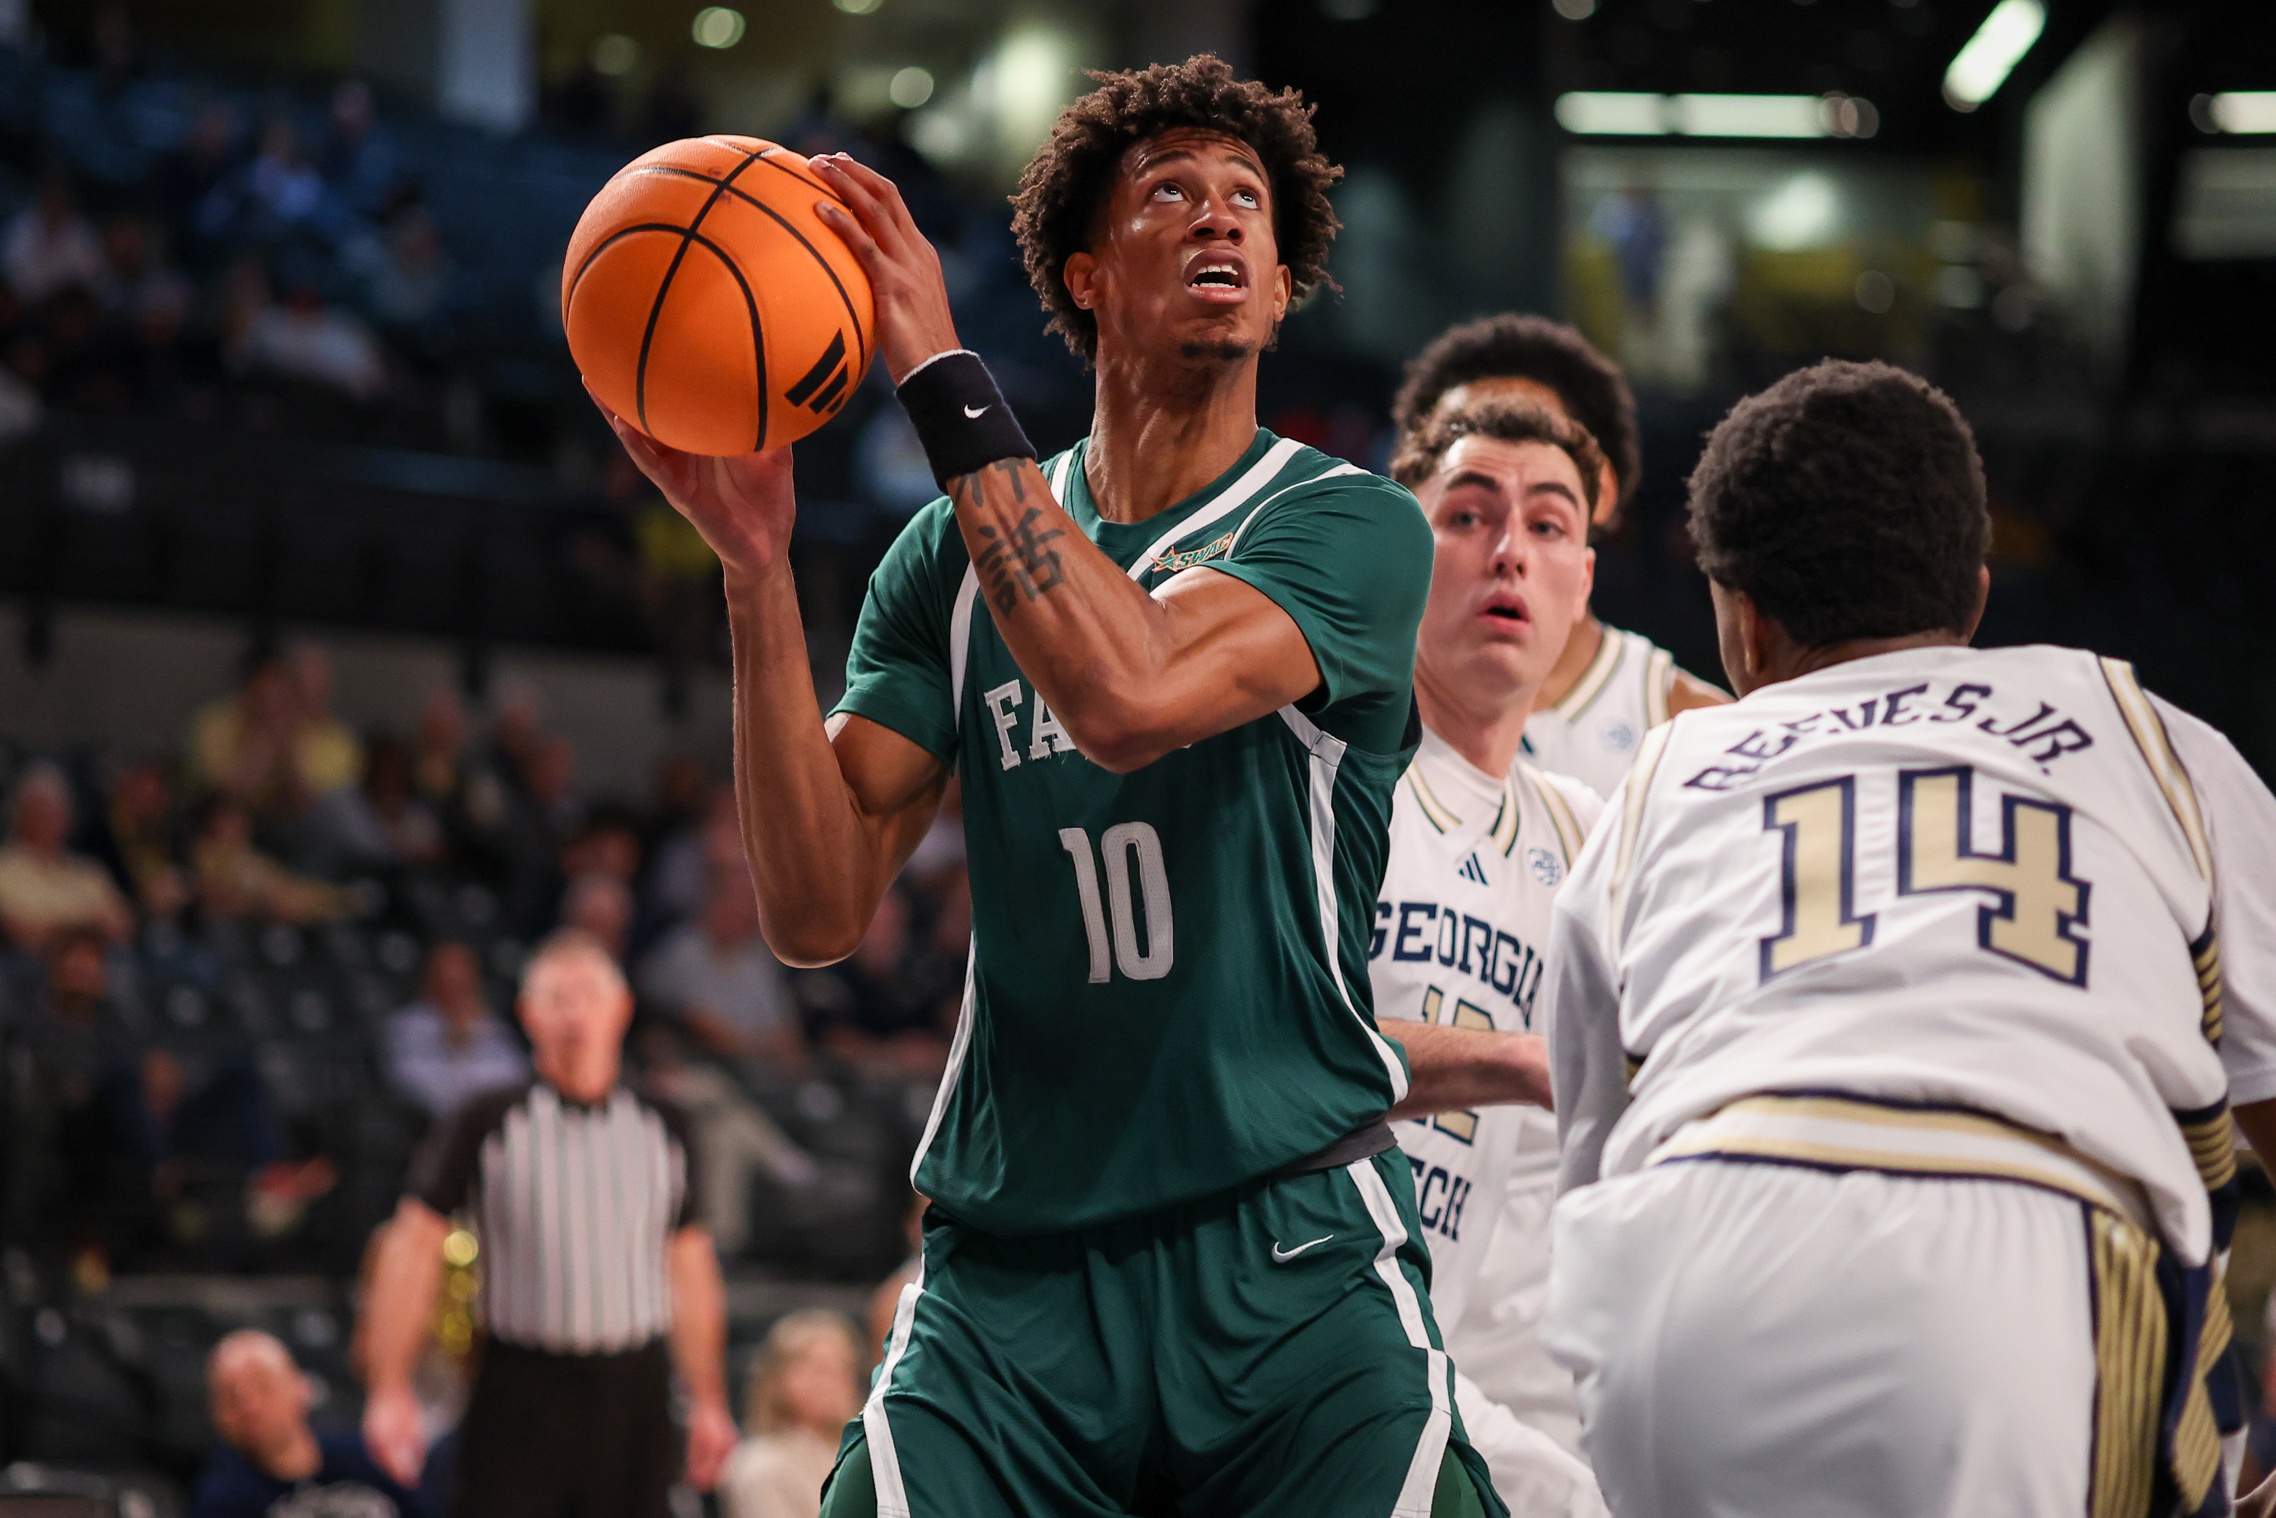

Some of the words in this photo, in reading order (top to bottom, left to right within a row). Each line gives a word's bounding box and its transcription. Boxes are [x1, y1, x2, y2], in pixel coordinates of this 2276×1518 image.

[1683, 683, 1993, 791] REEVES
[1058, 821, 1174, 983] 10
[1759, 765, 2092, 989] 14
[1406, 1155, 1471, 1242] CH
